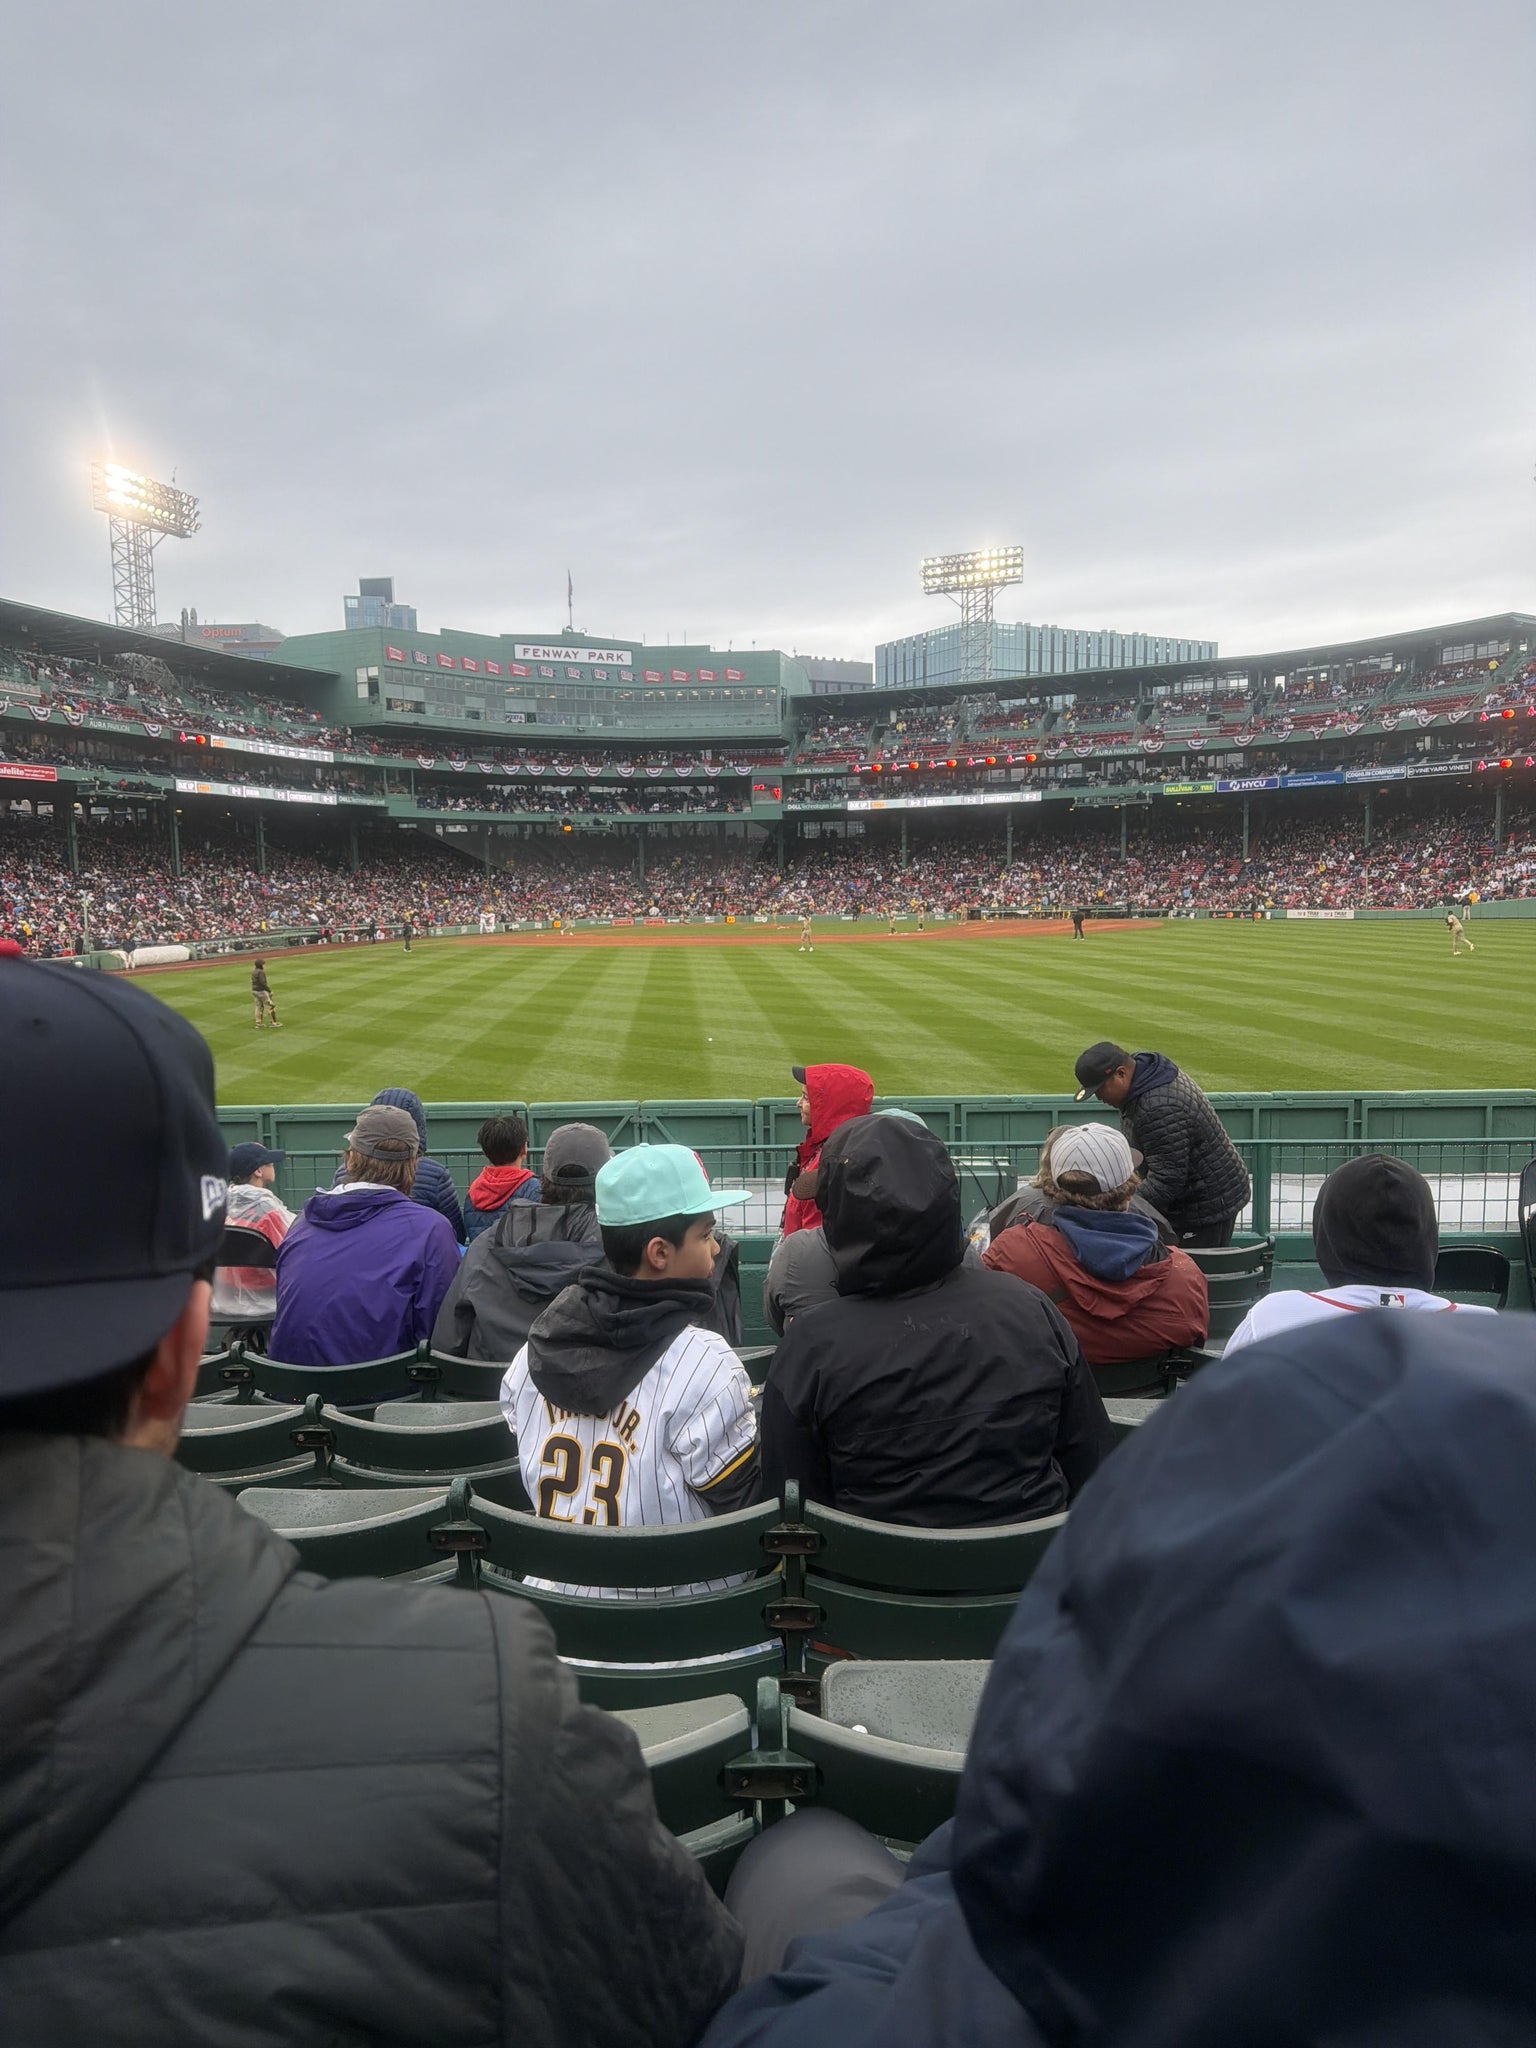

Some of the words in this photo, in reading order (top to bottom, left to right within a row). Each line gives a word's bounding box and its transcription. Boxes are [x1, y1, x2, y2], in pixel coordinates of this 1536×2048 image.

[202, 627, 241, 638] Optum
[523, 647, 579, 659] FENWAY
[588, 651, 624, 662] PARK
[1415, 766, 1448, 774] VINEYARD
[1241, 781, 1267, 789] HYCU
[612, 1400, 641, 1455] JR.
[537, 1433, 627, 1526] 23
